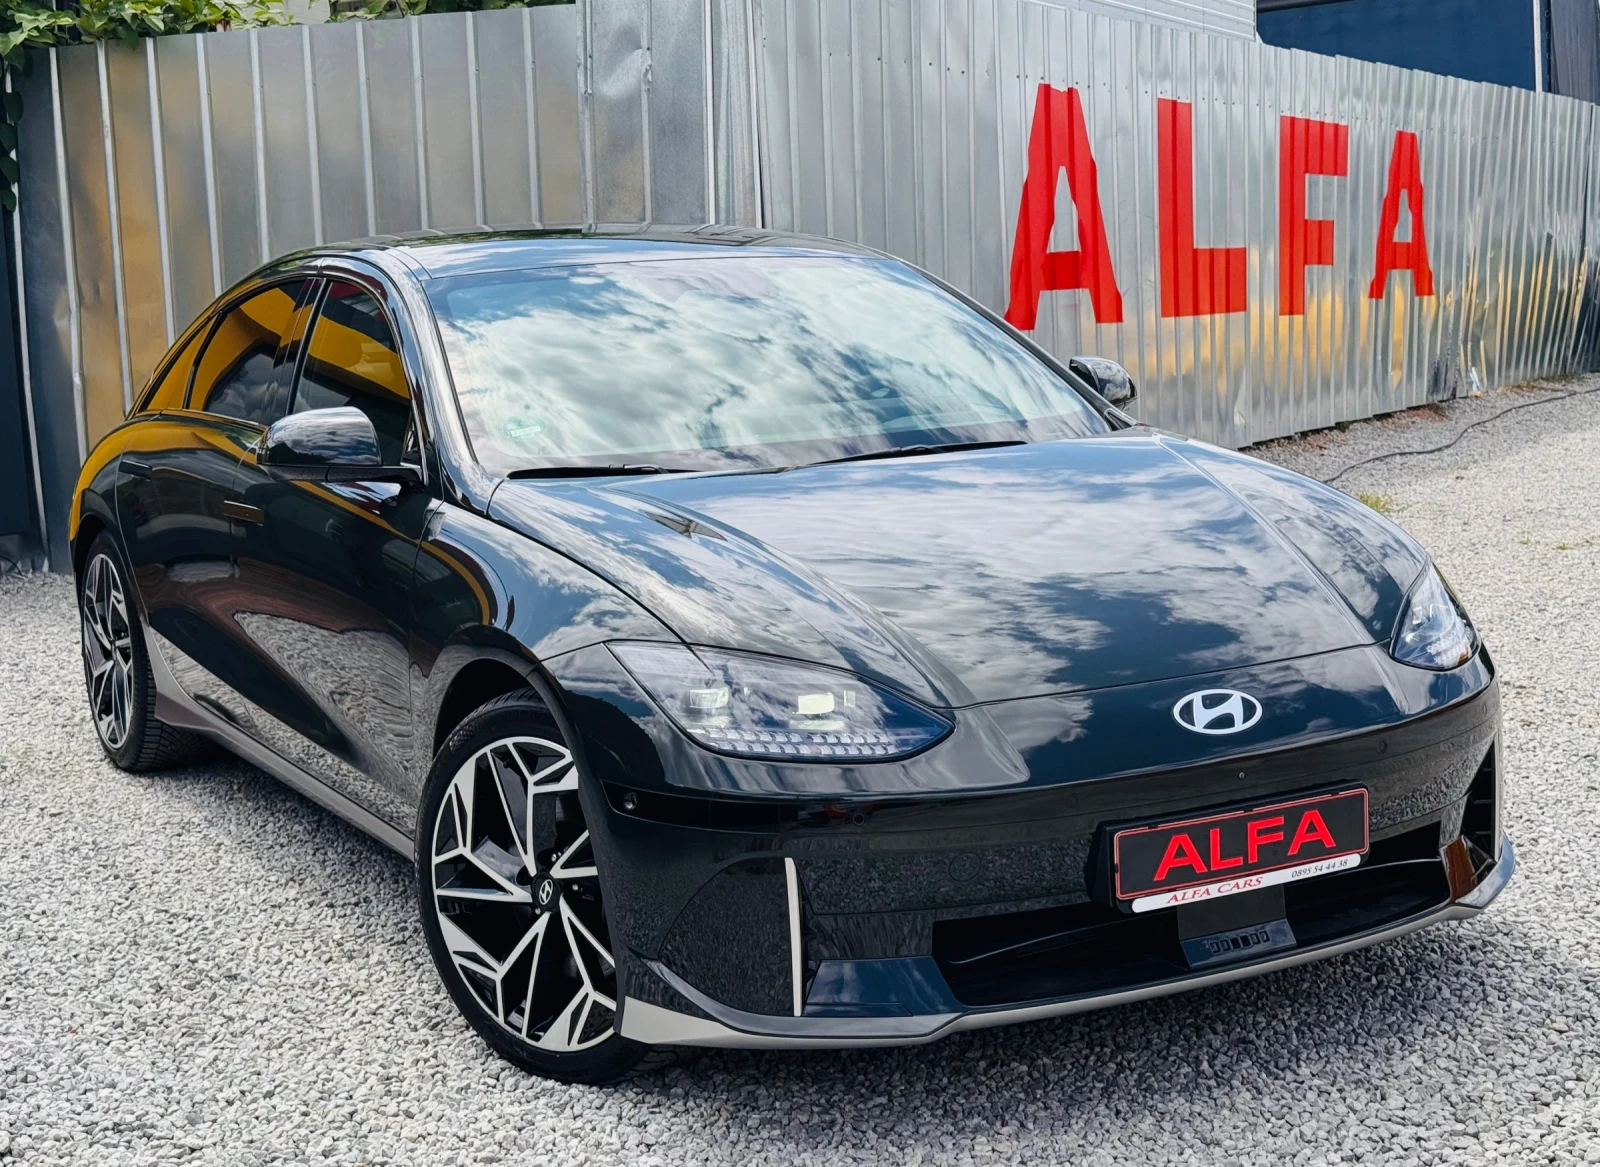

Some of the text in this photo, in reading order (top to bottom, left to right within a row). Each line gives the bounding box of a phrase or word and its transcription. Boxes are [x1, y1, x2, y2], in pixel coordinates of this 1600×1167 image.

[1004, 83, 1435, 330] ALFA
[1153, 809, 1336, 882] ALFA
[1166, 859, 1348, 904] ALFA CARS 0895 54 44 38
